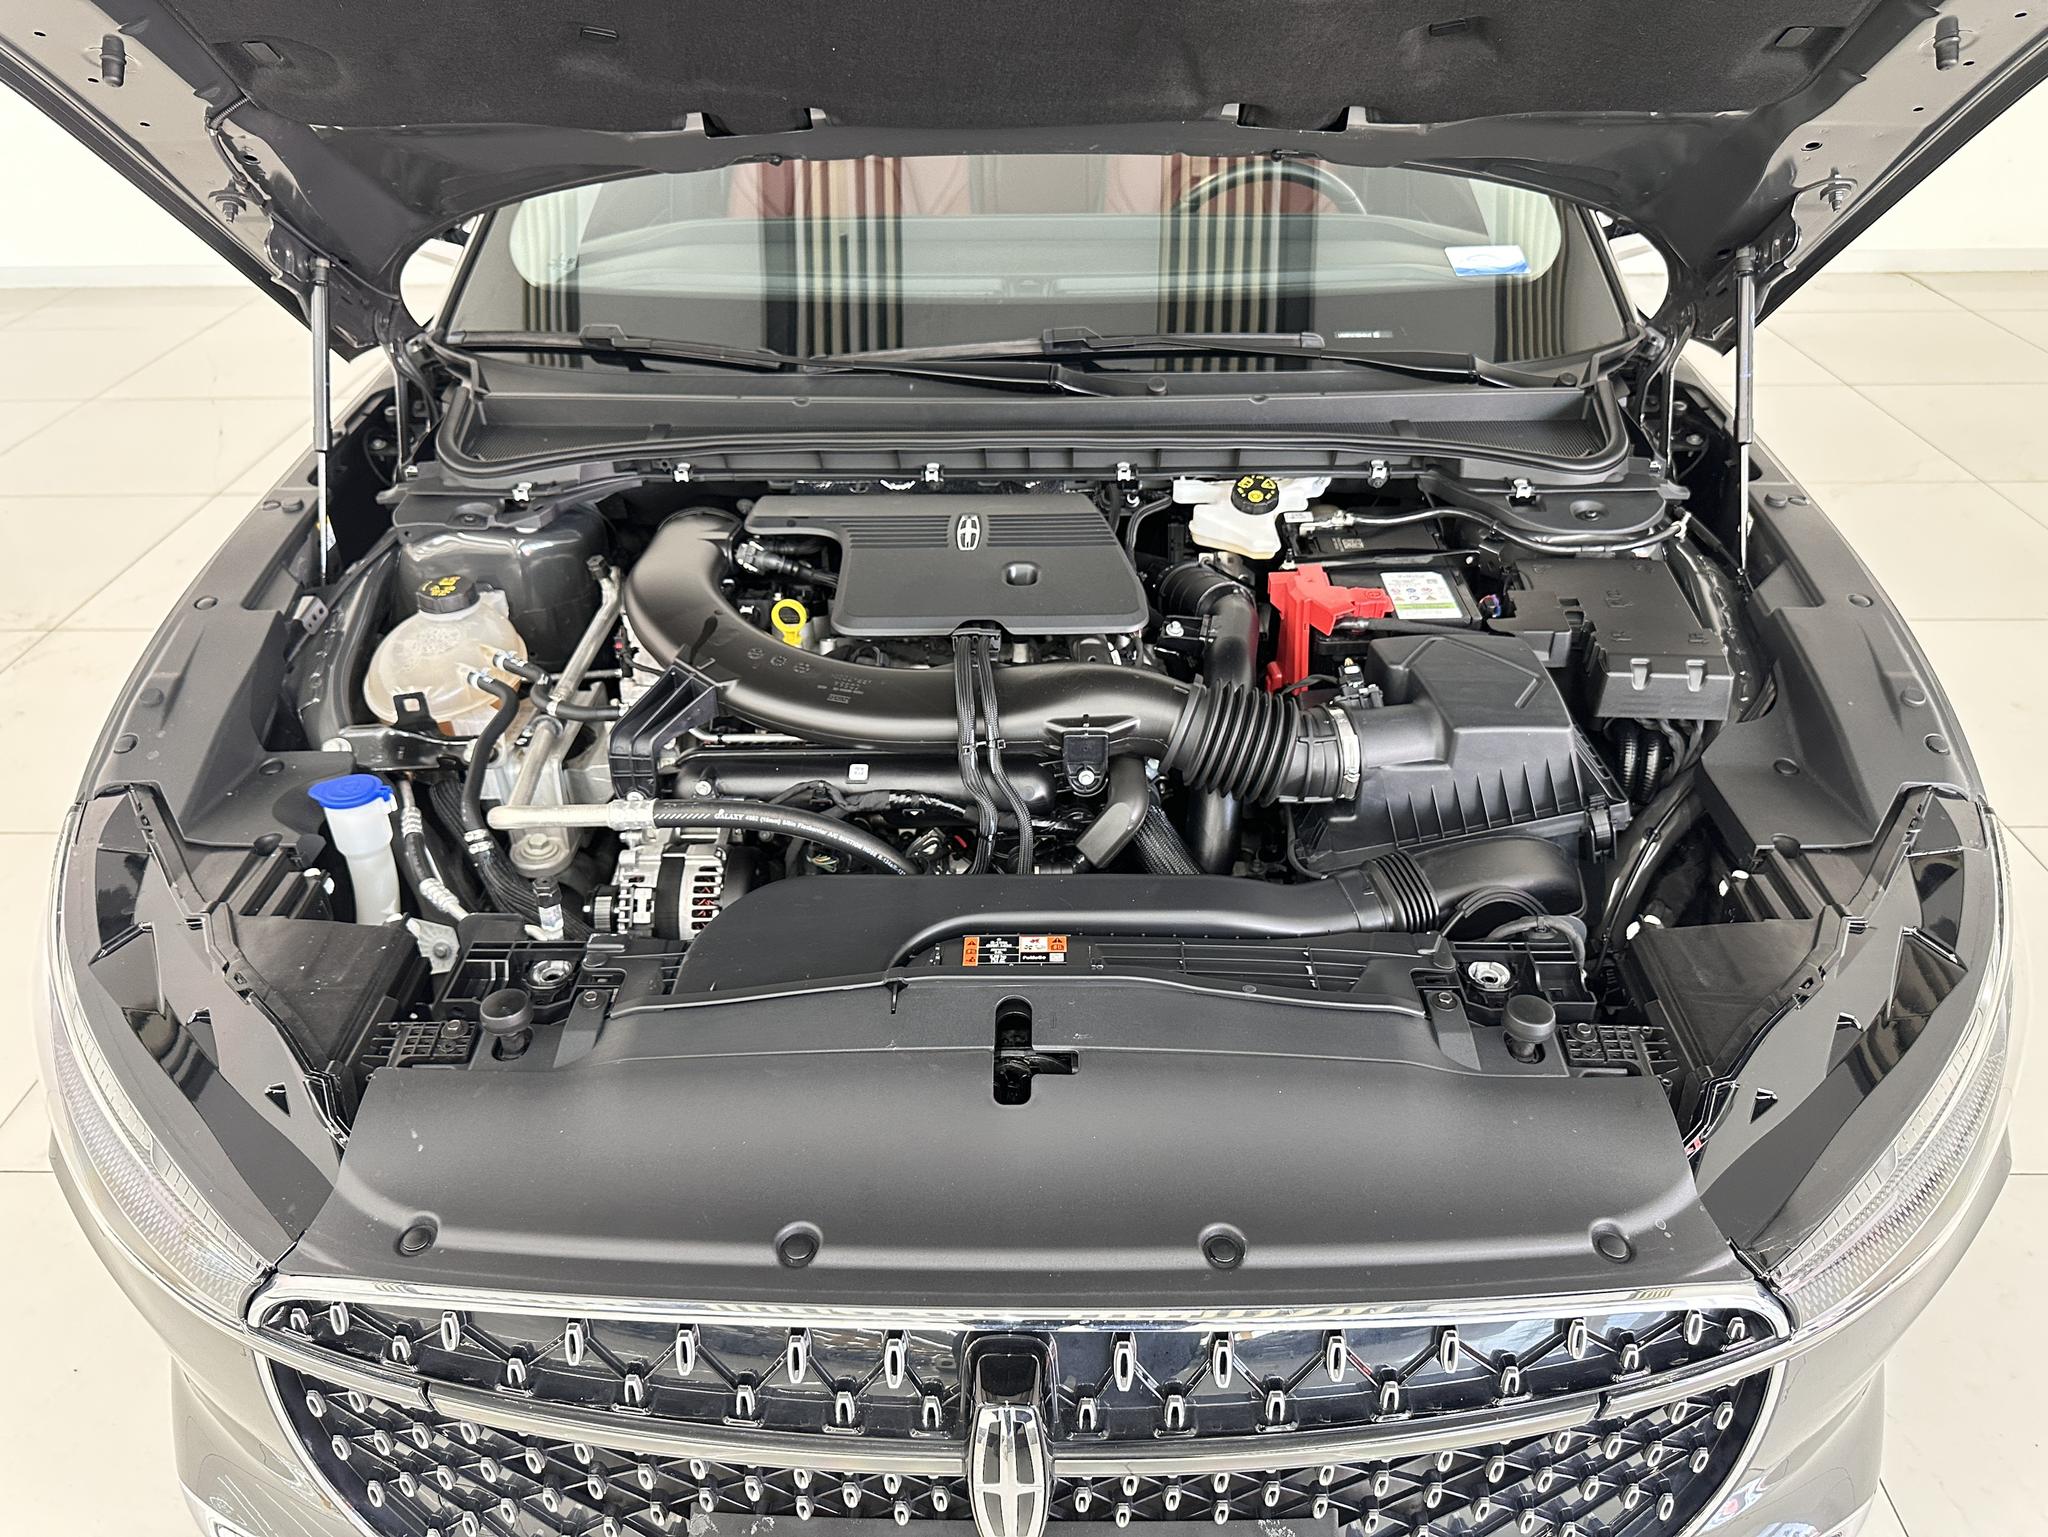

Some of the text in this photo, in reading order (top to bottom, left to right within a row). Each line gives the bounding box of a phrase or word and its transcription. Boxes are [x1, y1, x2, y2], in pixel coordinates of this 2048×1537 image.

[714, 809, 744, 820] GALAXY
[827, 831, 839, 840] A/C
[838, 835, 863, 850] SUCTION
[862, 845, 878, 858] HOSE
